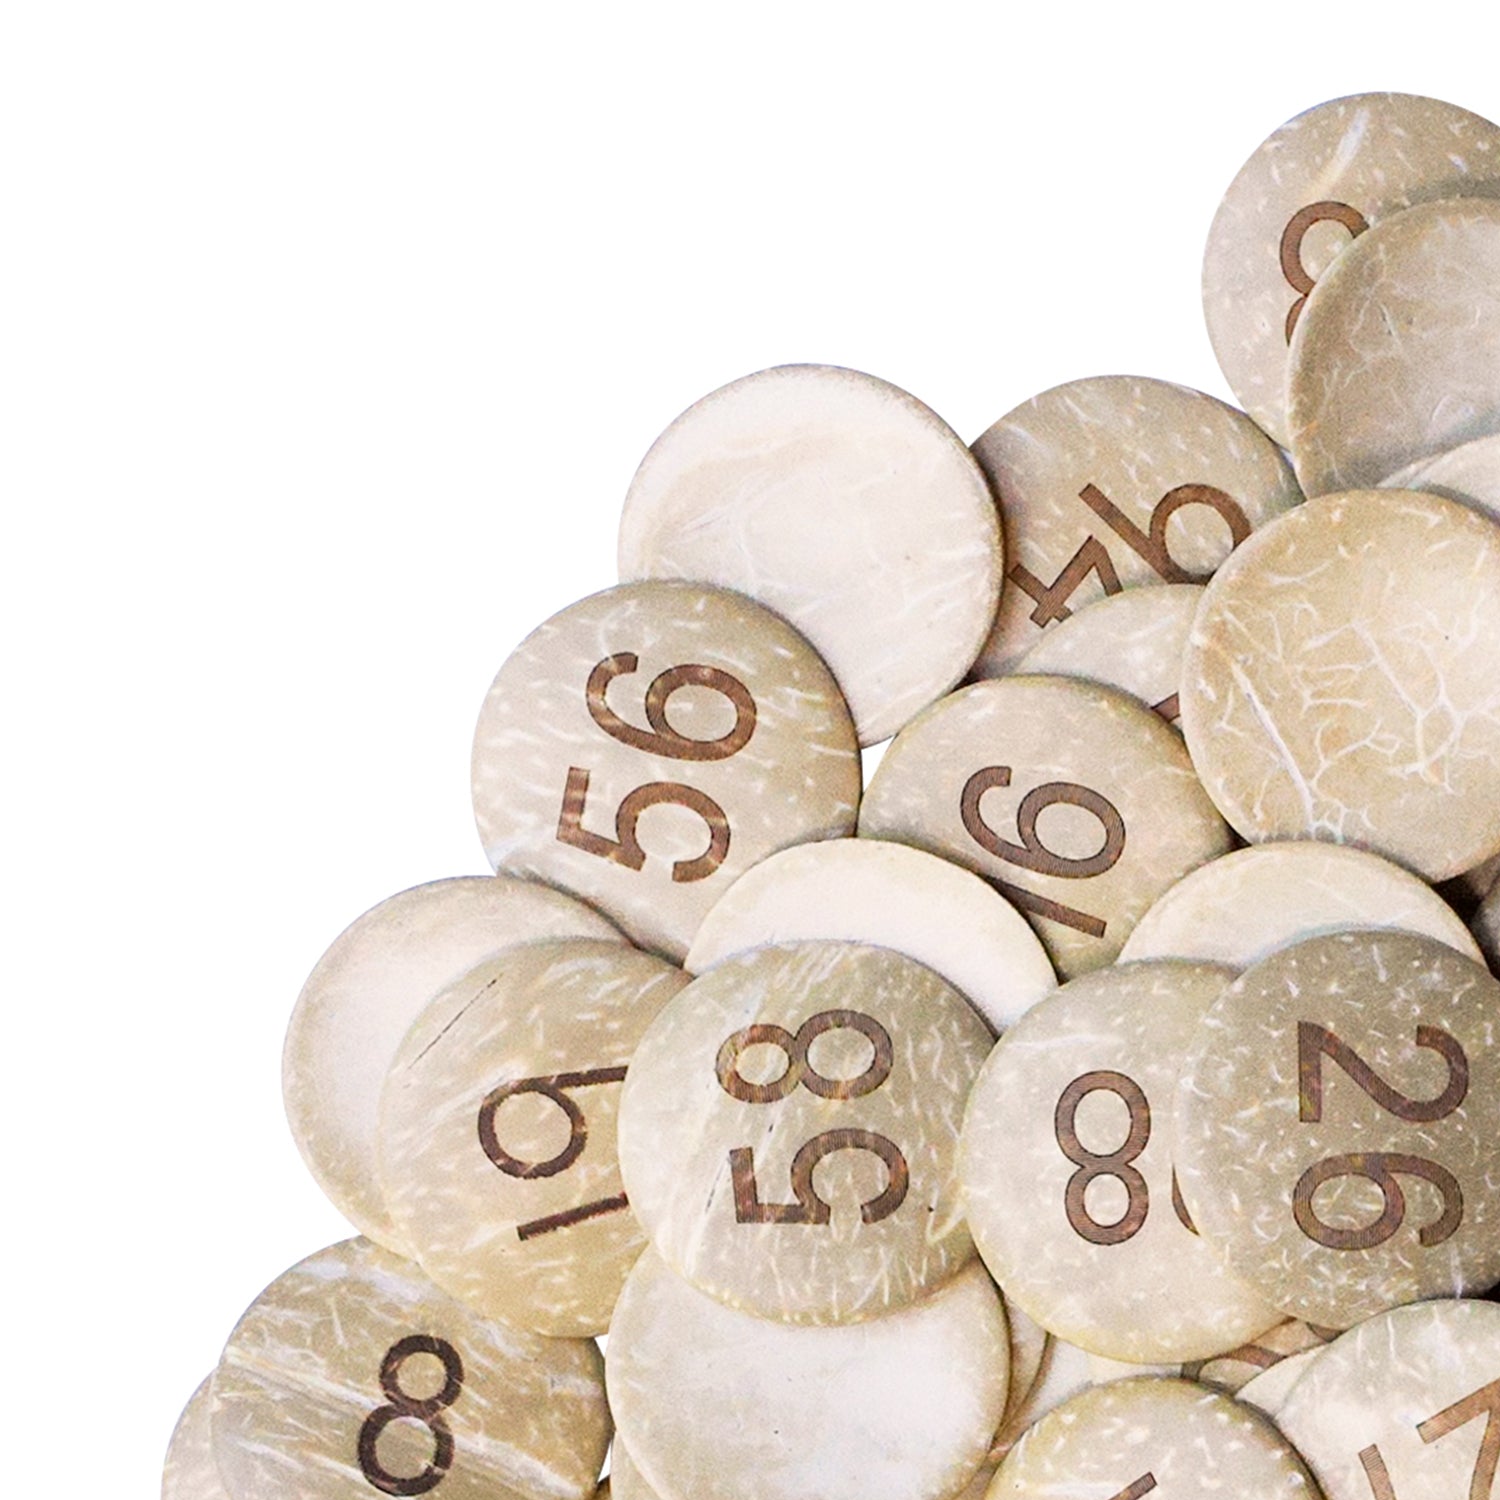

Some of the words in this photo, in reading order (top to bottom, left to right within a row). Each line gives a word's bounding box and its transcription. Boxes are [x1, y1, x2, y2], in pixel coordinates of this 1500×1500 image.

[1007, 481, 1253, 628] 94
[556, 651, 758, 883] 56
[960, 765, 1126, 938] 16
[476, 1065, 629, 1242] 19
[715, 1008, 910, 1226] 58
[1292, 1019, 1471, 1253] 26
[357, 1334, 464, 1497] 8
